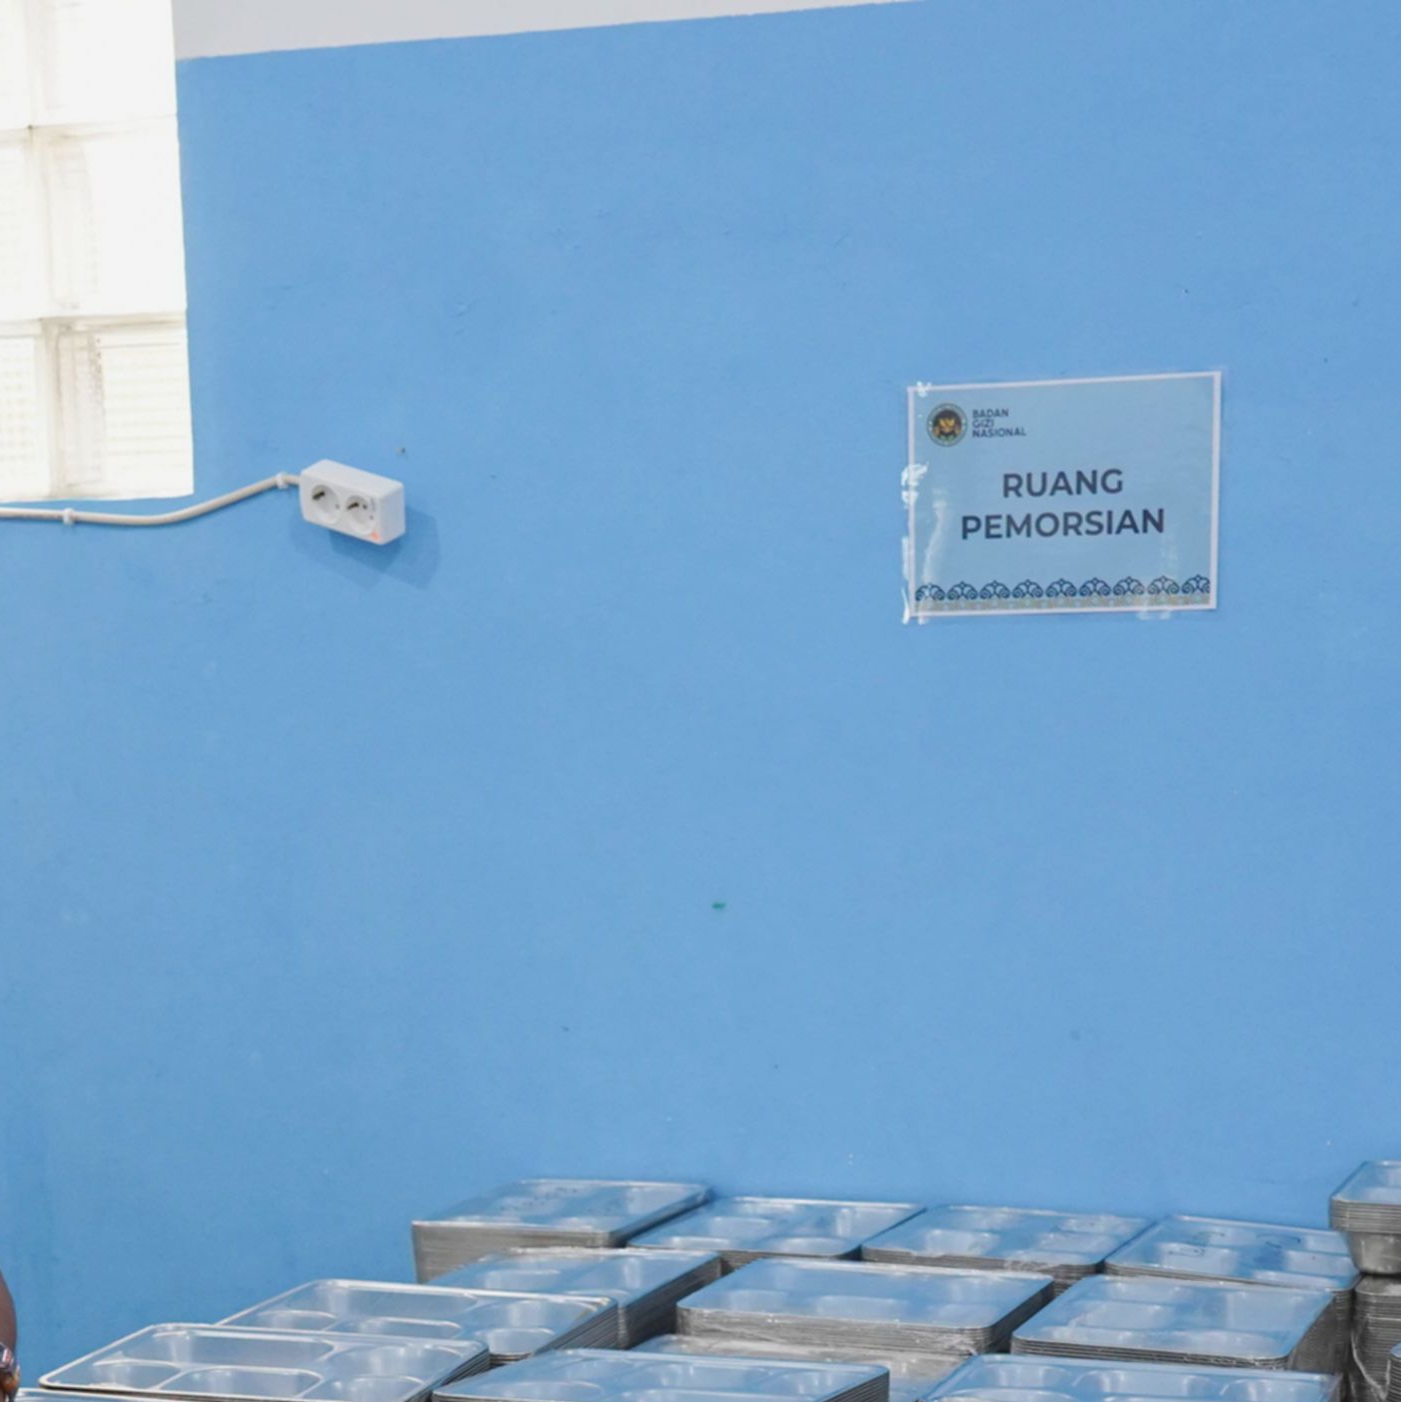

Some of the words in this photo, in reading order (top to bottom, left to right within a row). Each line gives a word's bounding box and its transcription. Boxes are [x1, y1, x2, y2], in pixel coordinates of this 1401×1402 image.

[972, 408, 1009, 418] BADAN
[972, 418, 994, 428] GIZI
[972, 427, 1027, 438] NASIONAL
[1002, 468, 1124, 498] RUANG
[961, 508, 1165, 540] PEMORSIAN
